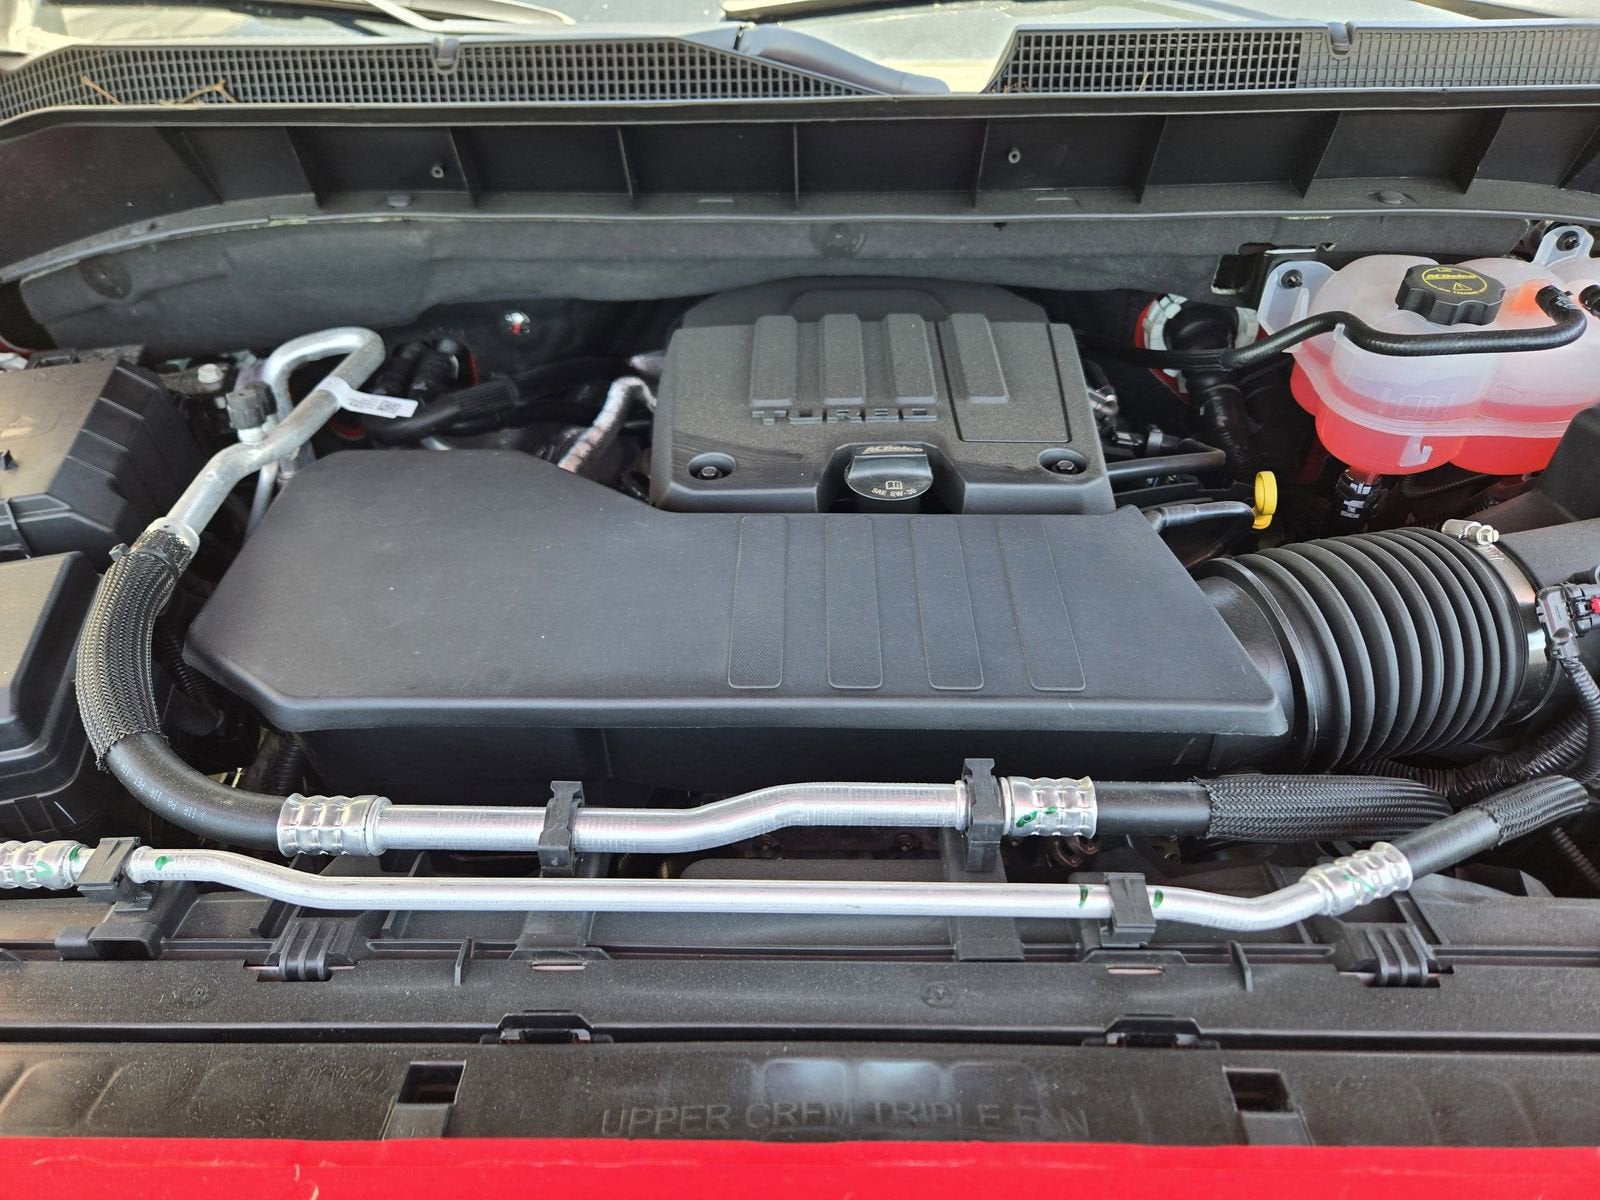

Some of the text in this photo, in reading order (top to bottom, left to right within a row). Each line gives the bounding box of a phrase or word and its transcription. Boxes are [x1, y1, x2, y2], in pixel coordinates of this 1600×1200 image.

[751, 408, 938, 425] TURBO
[871, 487, 887, 496] SAE
[602, 1104, 731, 1136] UPPER
[1014, 1105, 1090, 1137] FAN
